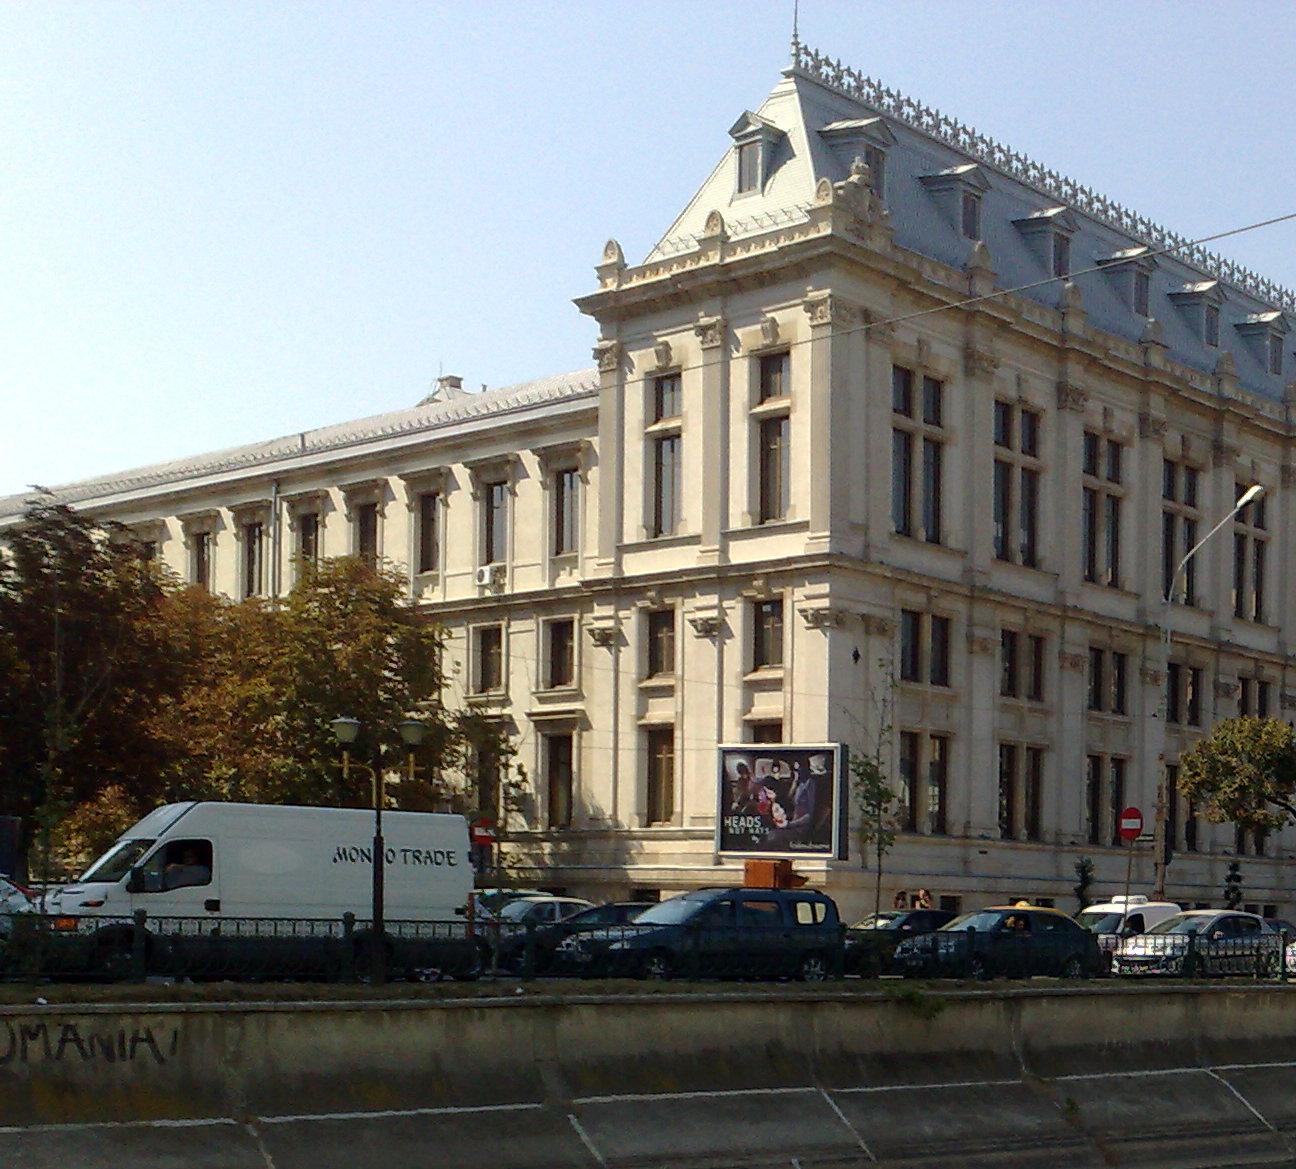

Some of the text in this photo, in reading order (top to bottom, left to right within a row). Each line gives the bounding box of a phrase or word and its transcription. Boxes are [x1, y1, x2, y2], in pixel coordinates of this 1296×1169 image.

[724, 815, 761, 828] HEADS
[332, 846, 457, 866] MONO TRADE
